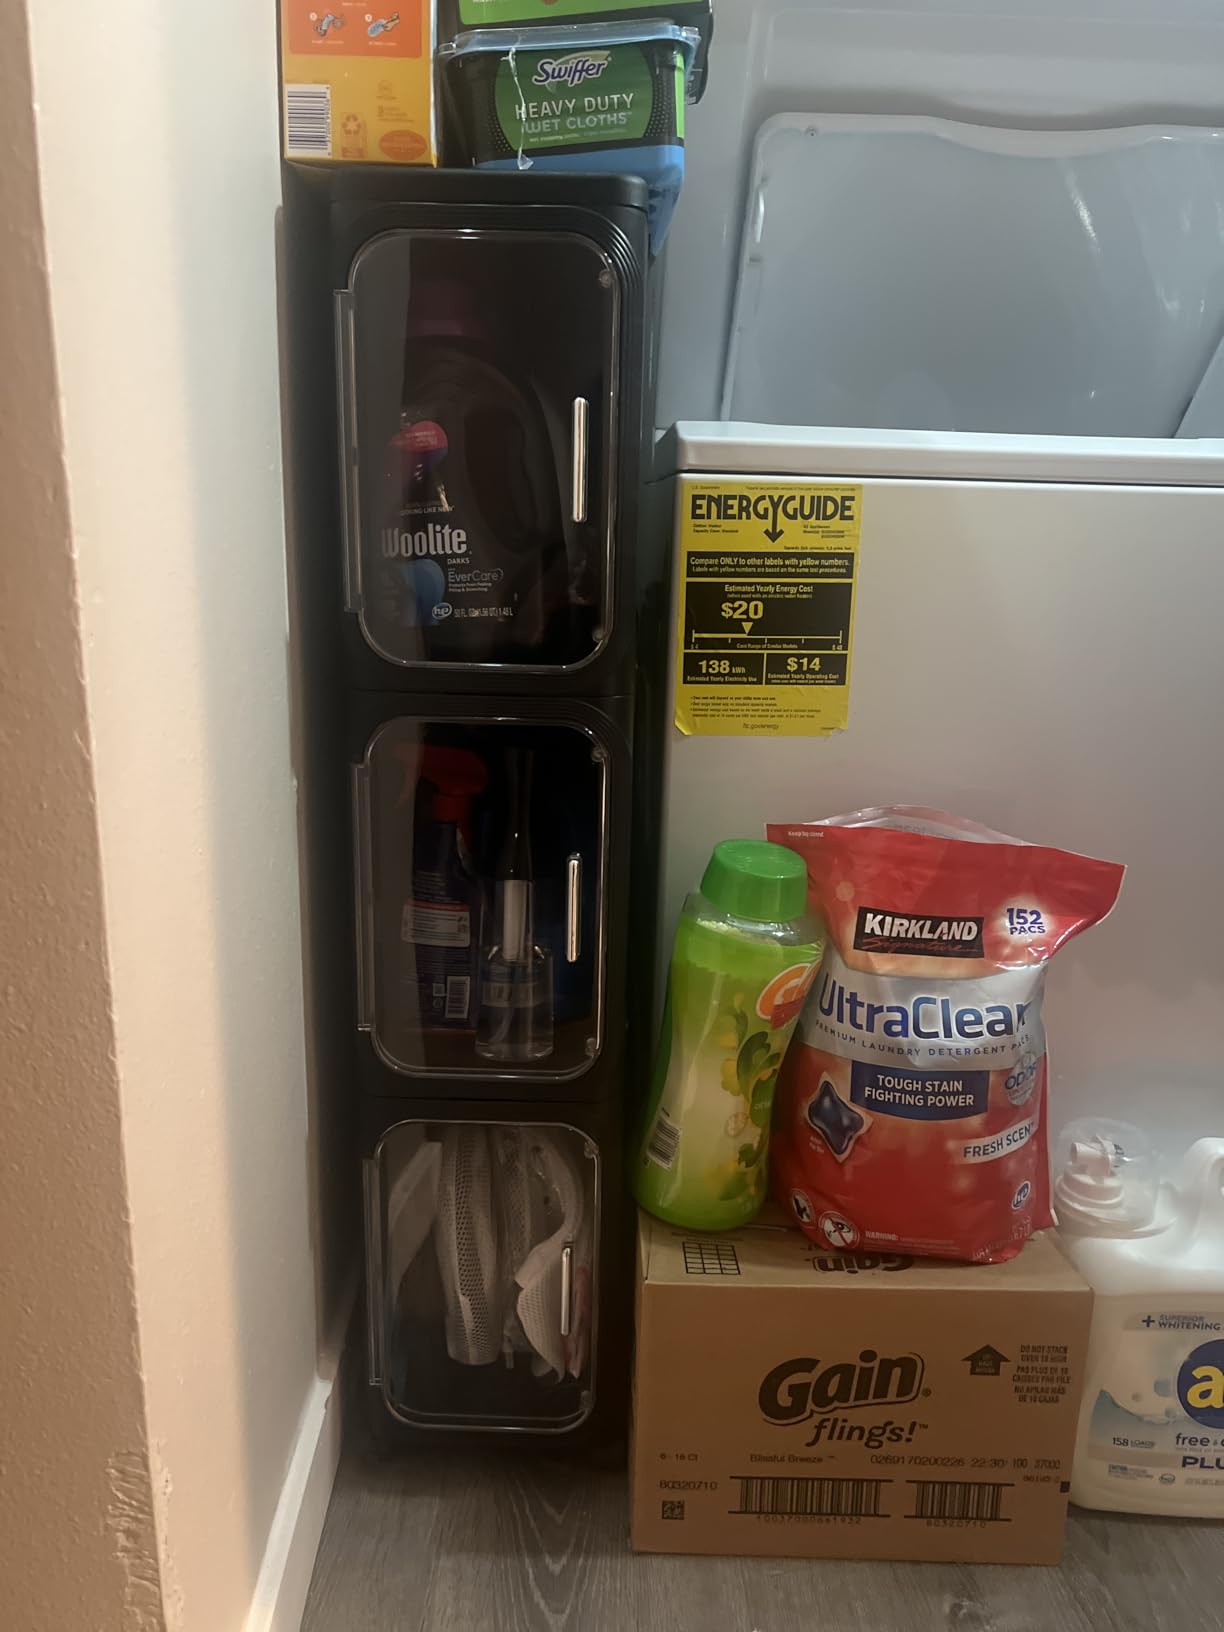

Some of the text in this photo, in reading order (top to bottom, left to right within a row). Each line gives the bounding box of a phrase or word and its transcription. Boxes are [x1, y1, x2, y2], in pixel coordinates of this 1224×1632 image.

[533, 57, 608, 87] Swiffer
[515, 92, 634, 120] HEAVY DUTY
[524, 111, 628, 134] WET CLOTHS
[690, 493, 856, 522] ENERGYGUIDE
[381, 523, 467, 558] Woolite
[447, 557, 470, 565] DARKS
[690, 556, 719, 566] Compare
[720, 556, 738, 565] ONLY
[739, 556, 745, 565] to
[747, 556, 763, 565] other
[764, 556, 783, 565] labels
[784, 556, 798, 565] with
[799, 556, 820, 566] yellow
[448, 569, 499, 582] EverCare
[724, 584, 813, 594] Estimated Yearly Energy Cost
[433, 604, 452, 617] he
[721, 600, 764, 619] $20
[698, 659, 730, 674] 138
[786, 656, 821, 672] $14
[864, 912, 979, 941] KIRKLAND
[1006, 907, 1042, 927] 152
[1009, 924, 1046, 936] PACS
[818, 973, 1032, 1040] UltraClear
[815, 1020, 856, 1044] PREMIUM
[861, 1040, 921, 1057] LAUNDRY
[928, 1046, 1006, 1057] DETERGENT
[877, 1073, 963, 1092] TOUGH STAIN
[864, 1086, 974, 1107] FIGHTING POWER
[963, 1137, 1004, 1158] FRESH
[1158, 1320, 1221, 1331] WHITENING
[1159, 1313, 1205, 1323] SUPERIOR
[758, 1349, 922, 1423] Gain
[805, 1417, 917, 1449] flings!
[1112, 1436, 1129, 1447] 158
[1175, 1432, 1210, 1447] free
[750, 1453, 823, 1464] Blissful Breeze
